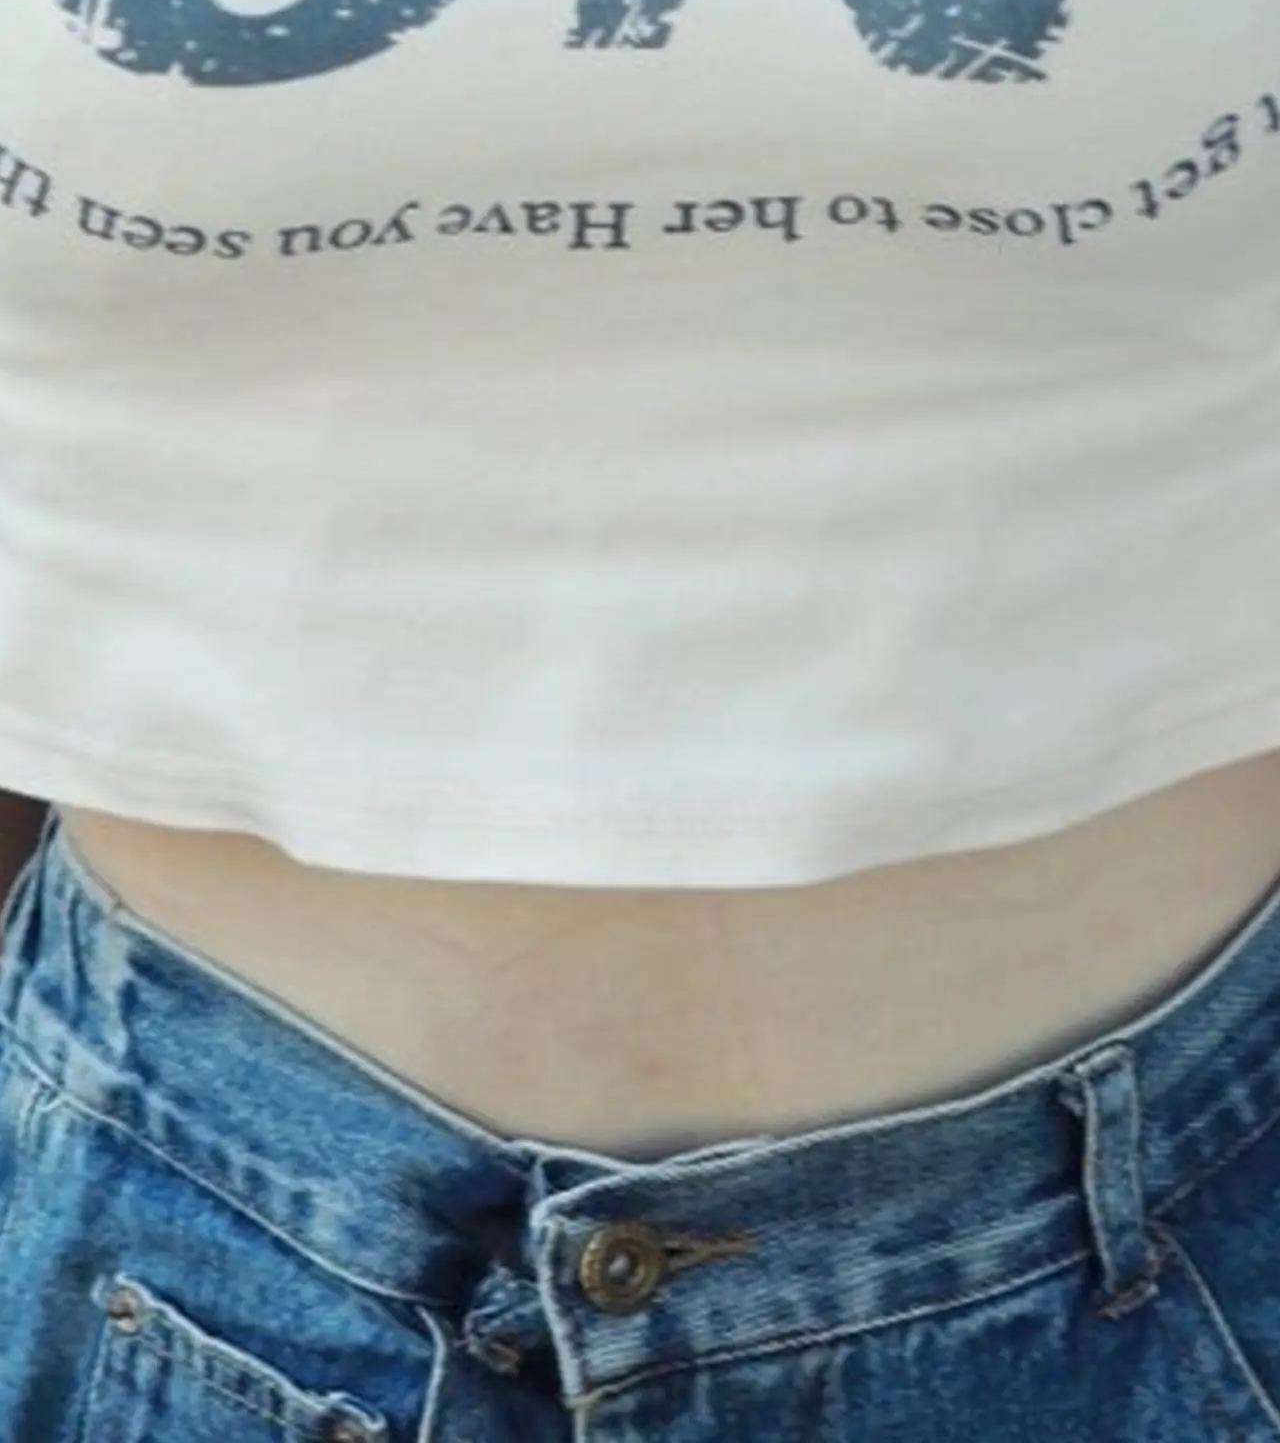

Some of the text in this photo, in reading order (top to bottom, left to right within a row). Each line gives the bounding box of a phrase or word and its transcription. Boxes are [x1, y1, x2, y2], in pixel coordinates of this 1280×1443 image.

[1130, 112, 1242, 220] get
[75, 194, 252, 261] seen
[278, 200, 421, 257] you
[437, 199, 634, 252] Have
[663, 193, 803, 243] her
[828, 193, 904, 230] to
[922, 195, 1115, 249] close
